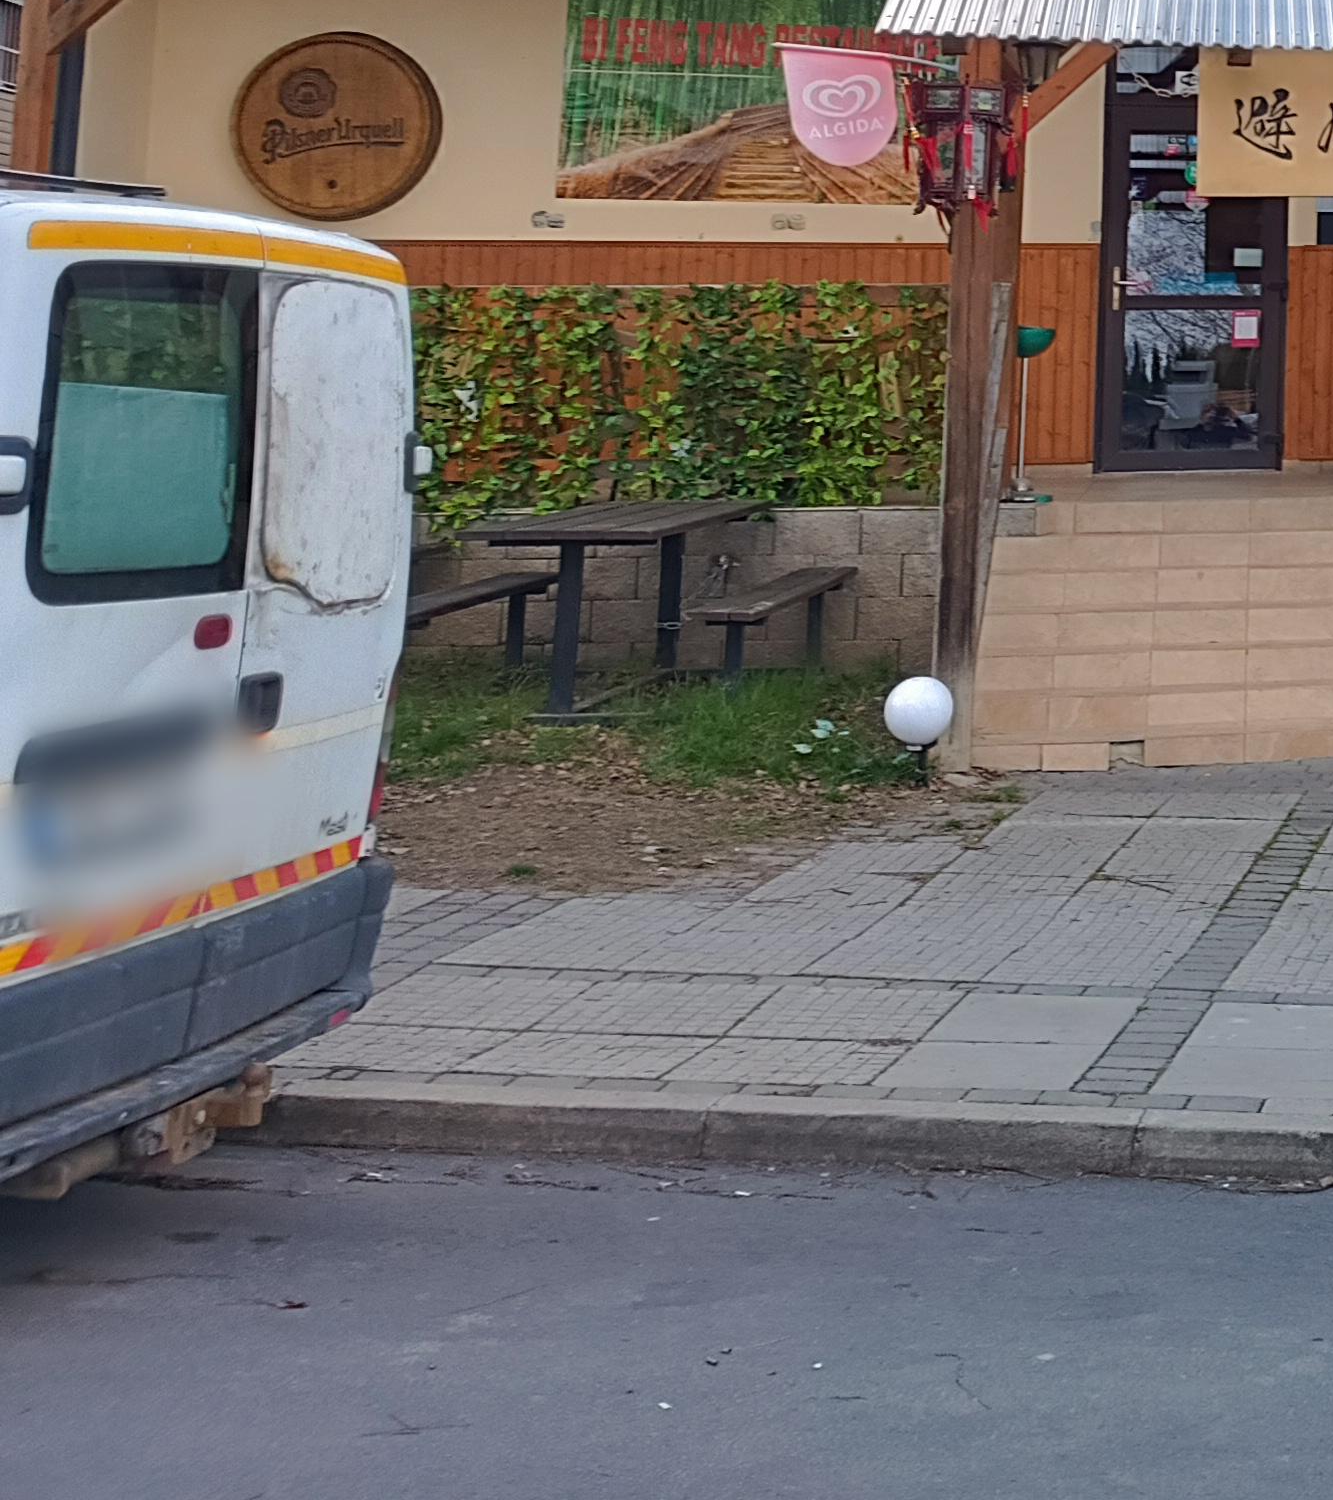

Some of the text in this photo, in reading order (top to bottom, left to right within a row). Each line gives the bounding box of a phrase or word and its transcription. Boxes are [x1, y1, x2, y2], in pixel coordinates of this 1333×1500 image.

[581, 16, 609, 63] BI
[615, 18, 689, 67] FENG
[696, 21, 767, 69] TANG
[261, 116, 405, 165] Pilsner Urquell
[808, 117, 884, 140] ALGIDA
